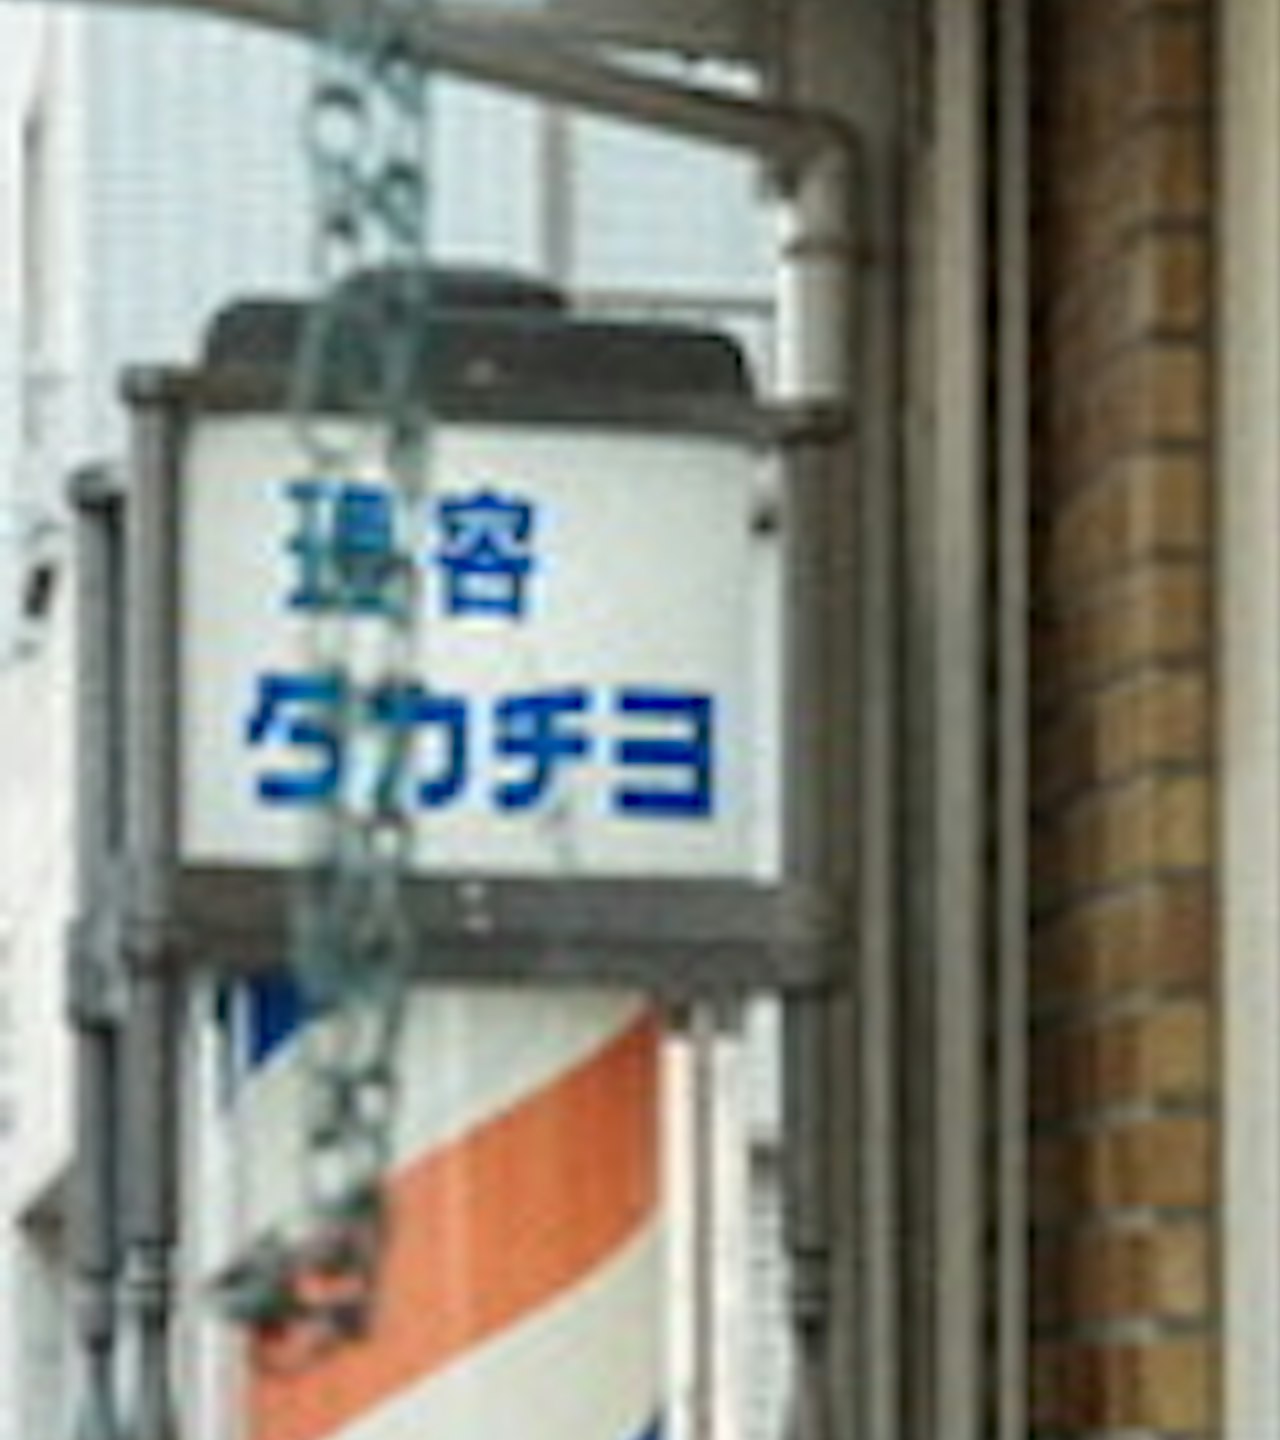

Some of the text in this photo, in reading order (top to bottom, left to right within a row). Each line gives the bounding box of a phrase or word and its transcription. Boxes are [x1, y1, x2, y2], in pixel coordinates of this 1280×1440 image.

[284, 479, 534, 620] 理容
[246, 672, 713, 816] タカチヨ
